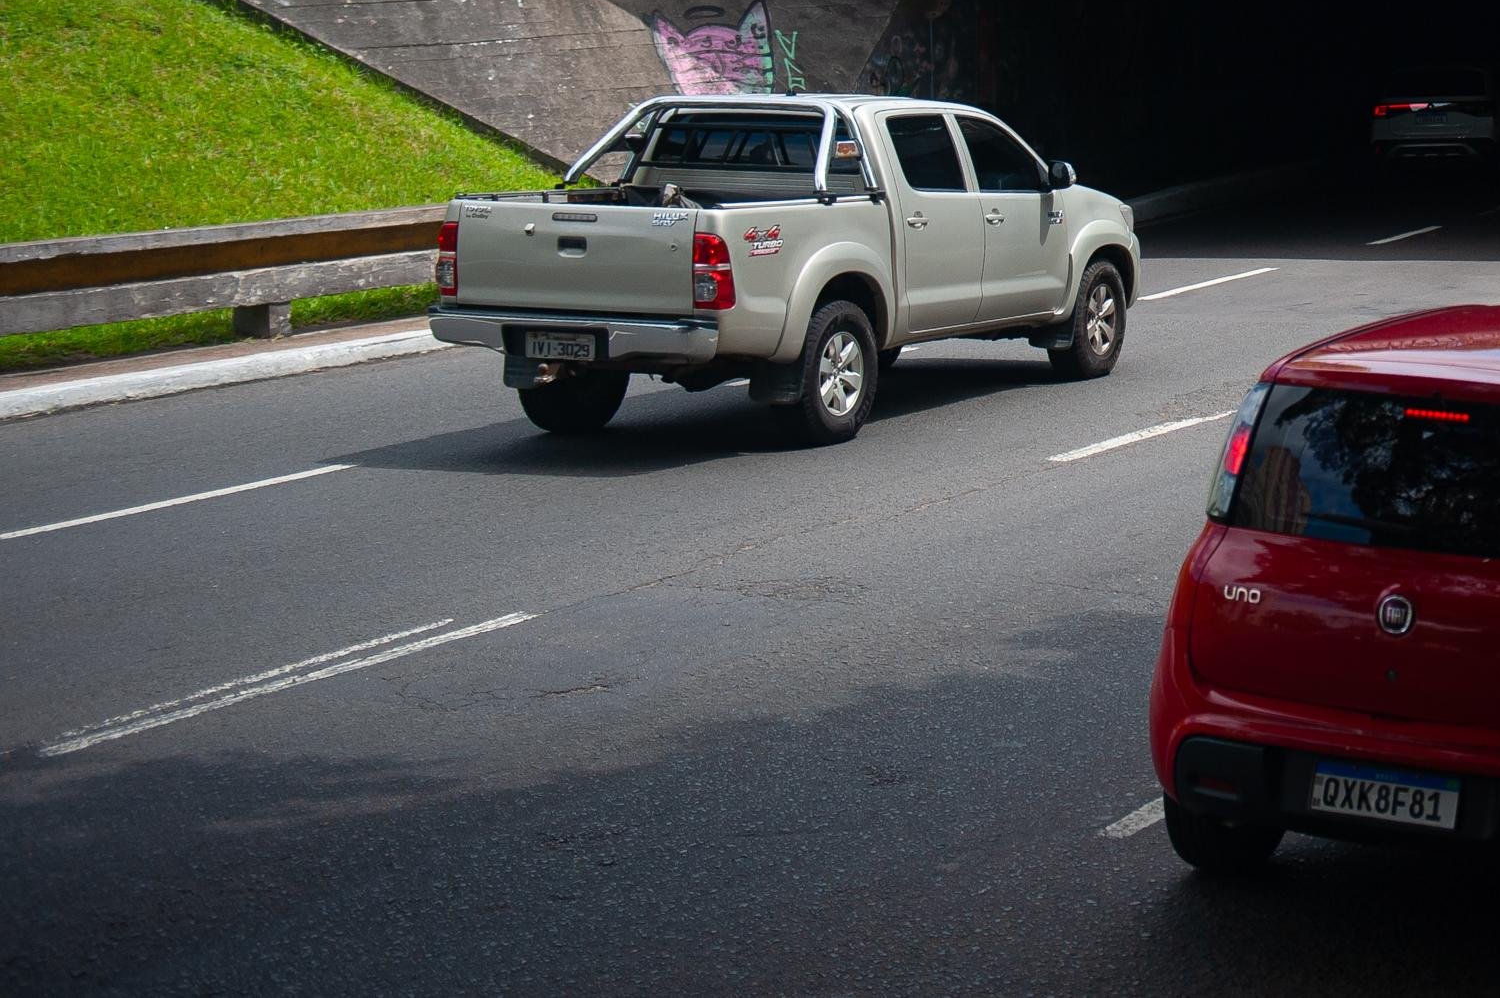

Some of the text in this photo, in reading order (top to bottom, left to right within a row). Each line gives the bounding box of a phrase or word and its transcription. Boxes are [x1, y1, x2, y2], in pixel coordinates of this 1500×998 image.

[653, 212, 689, 222] HILUX
[752, 239, 784, 250] TURBO
[1322, 777, 1441, 822] QXK8F81
